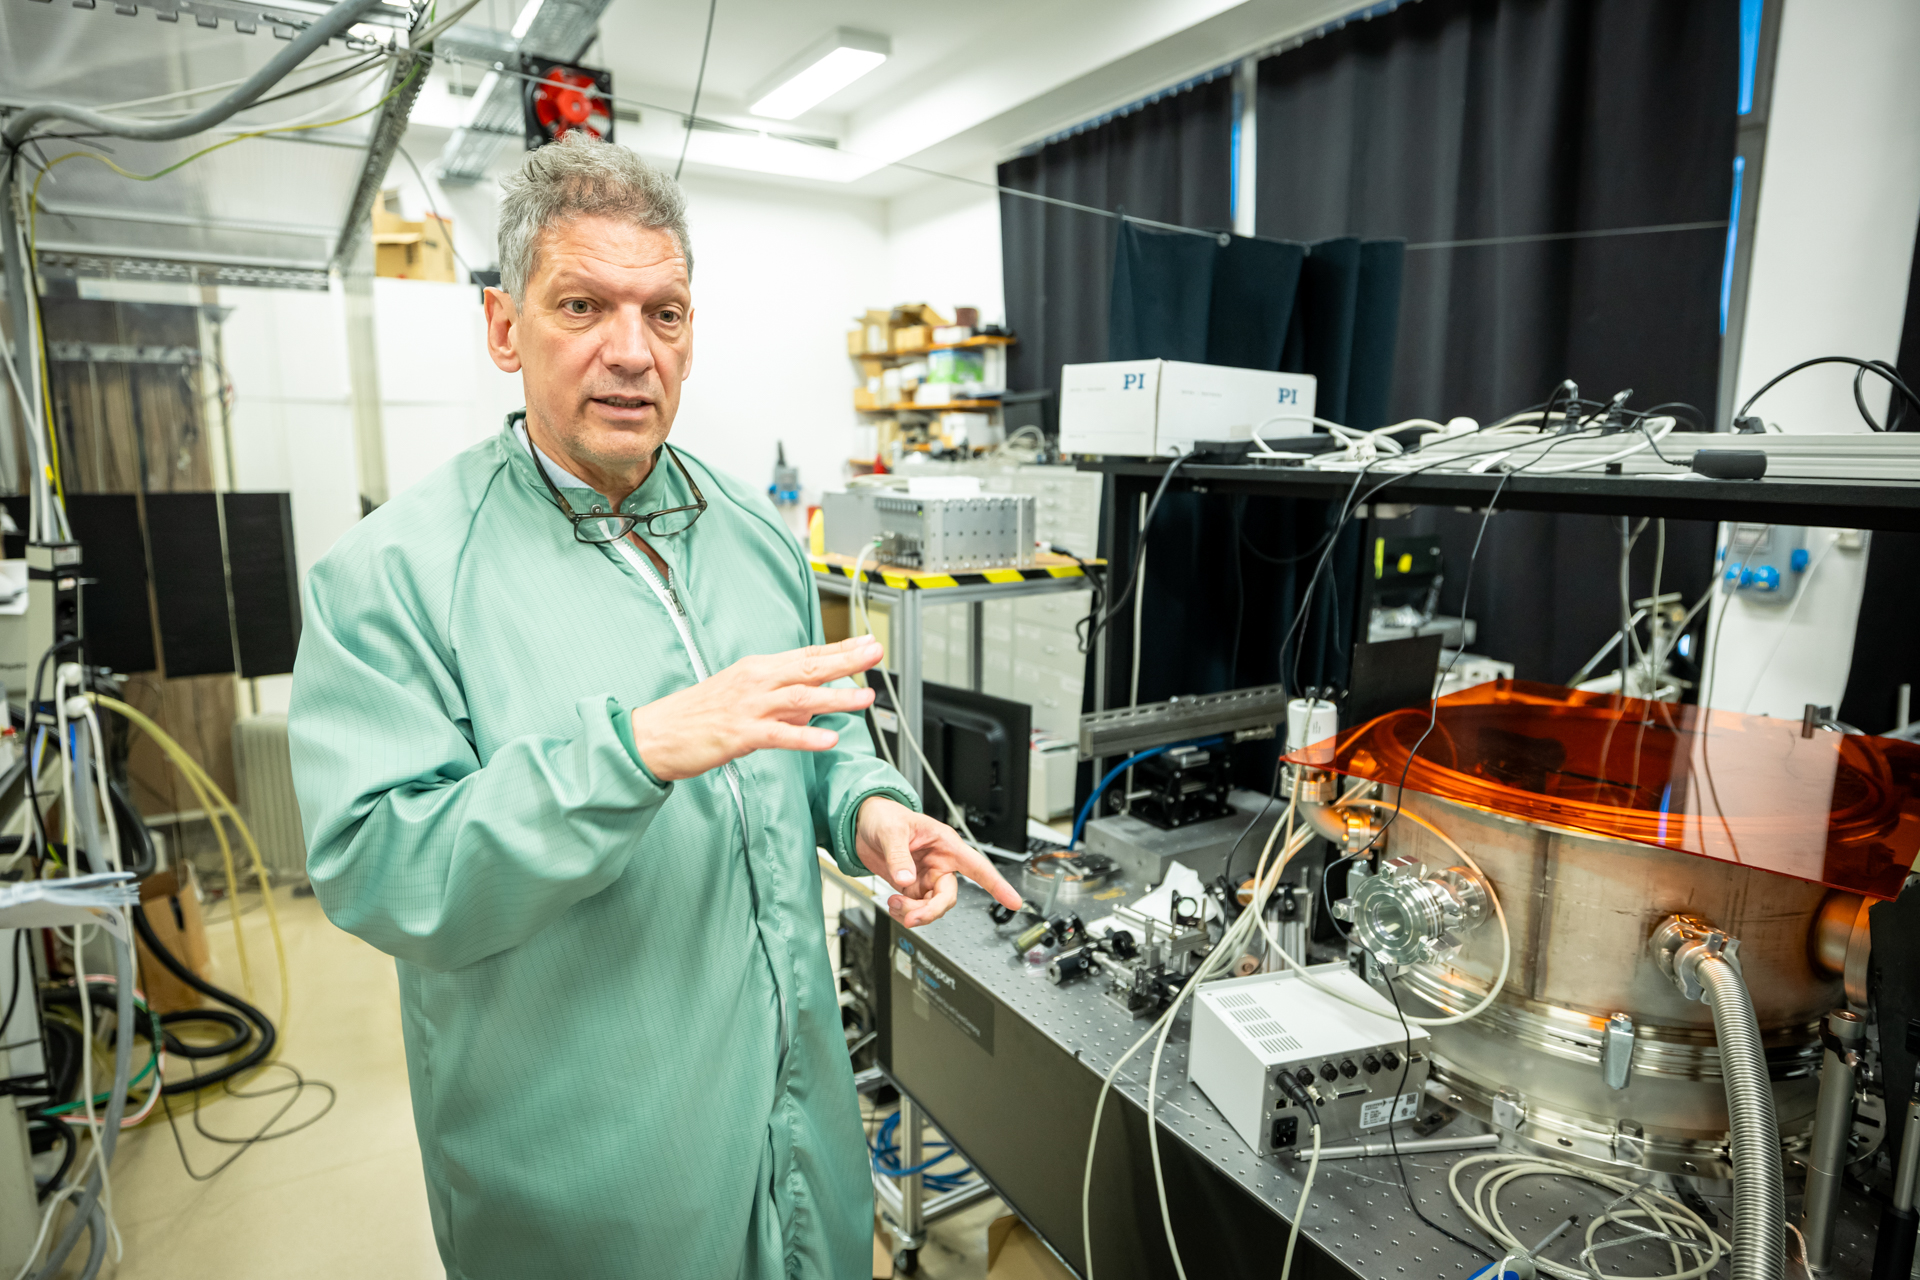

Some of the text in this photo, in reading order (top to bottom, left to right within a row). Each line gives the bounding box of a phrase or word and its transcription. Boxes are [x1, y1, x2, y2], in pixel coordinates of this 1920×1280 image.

[1123, 373, 1145, 390] PI
[1278, 387, 1298, 404] PI
[916, 950, 956, 990] Newport
